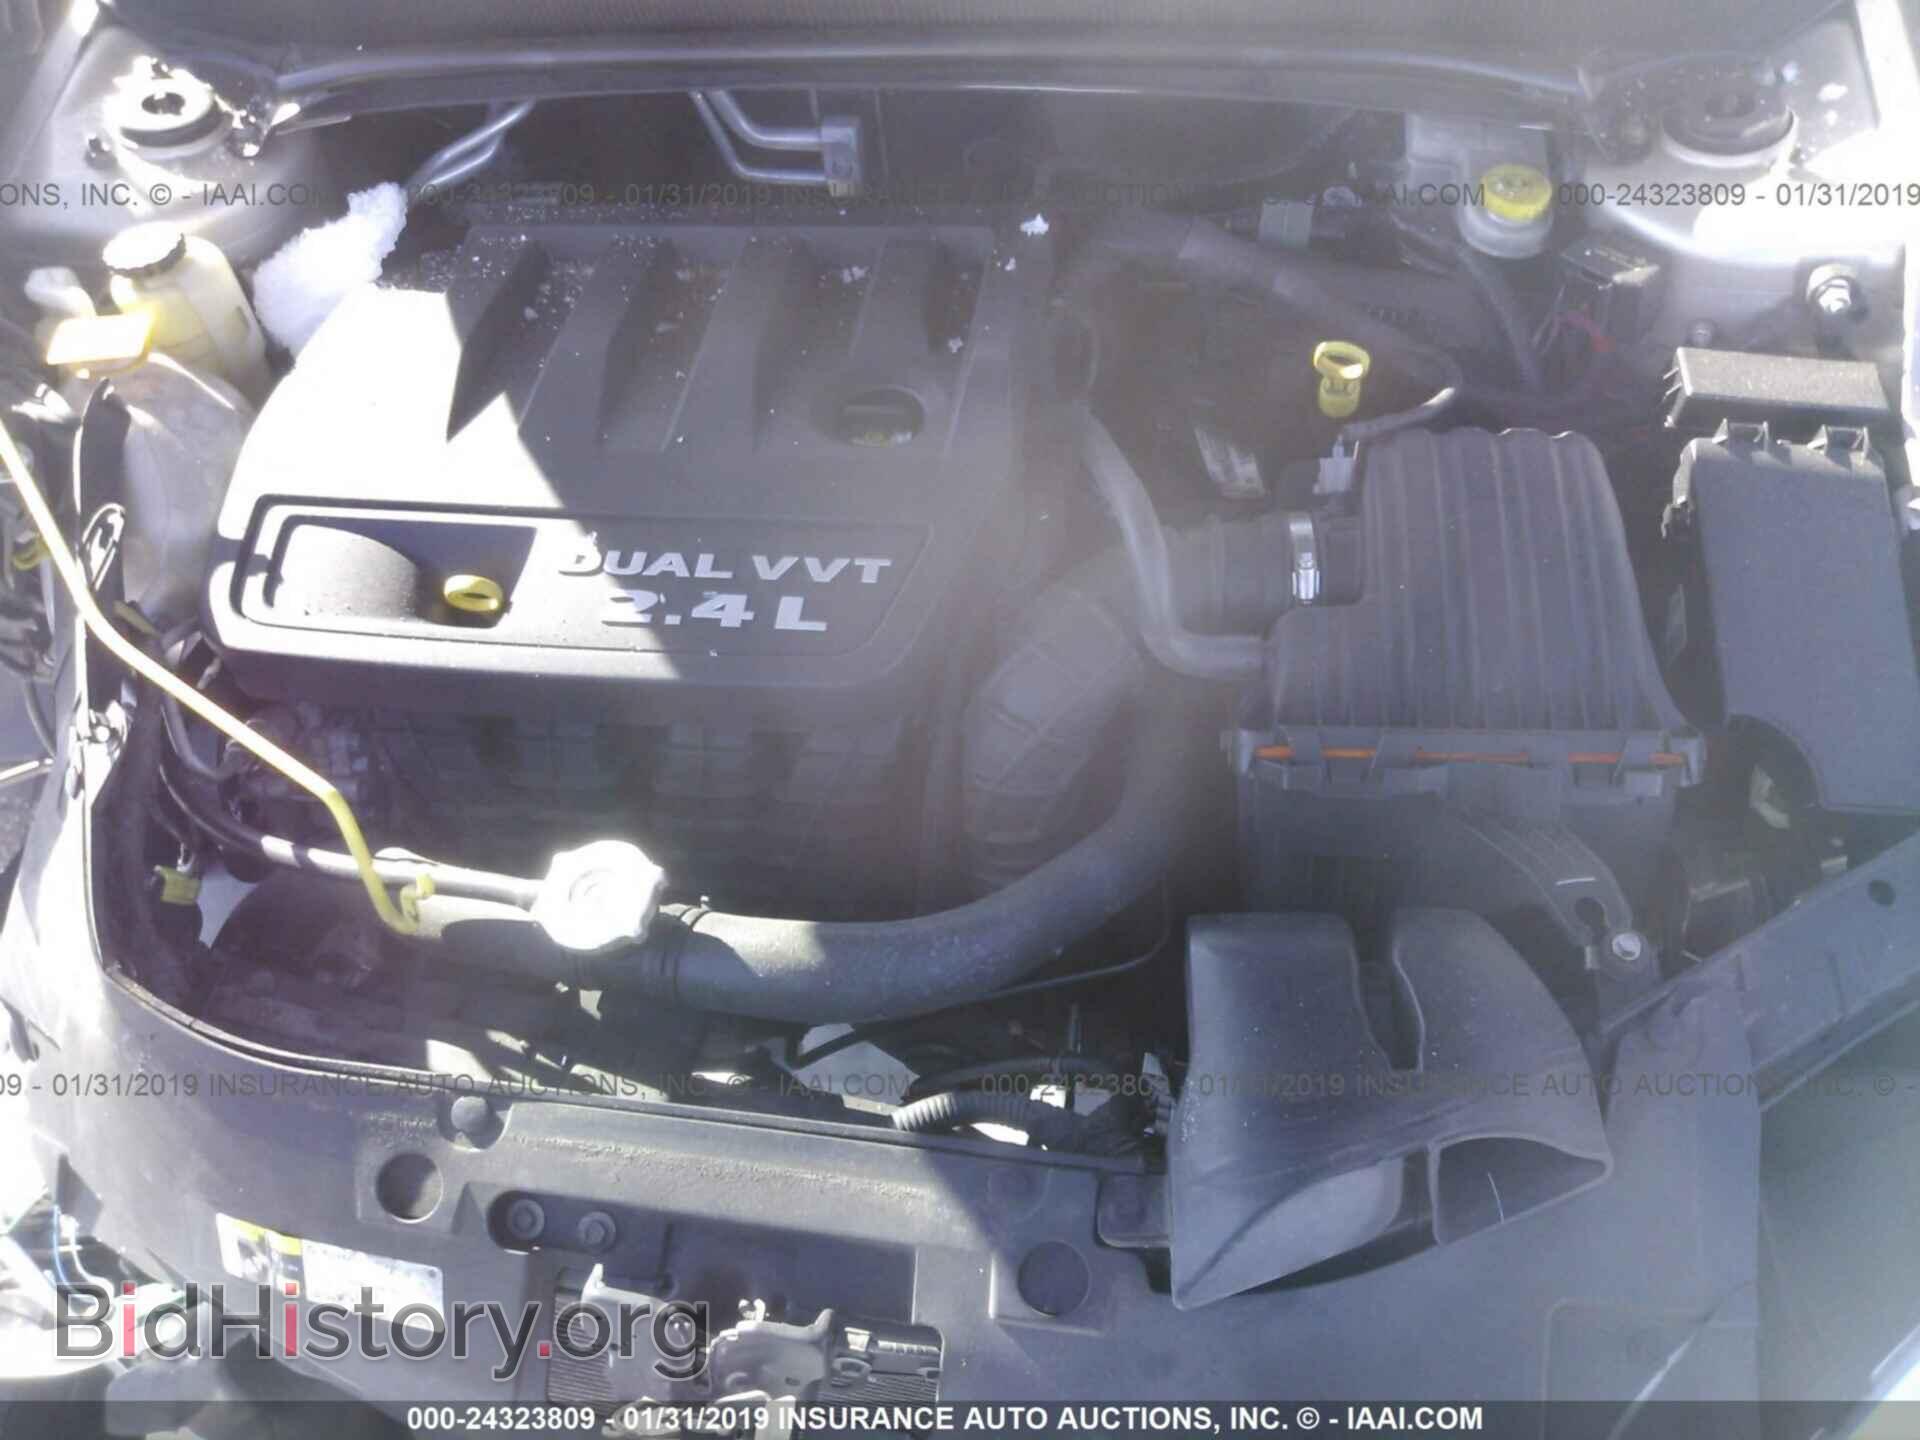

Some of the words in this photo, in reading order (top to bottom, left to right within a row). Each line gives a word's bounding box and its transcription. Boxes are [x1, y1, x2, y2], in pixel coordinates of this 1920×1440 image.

[558, 549, 733, 579] DUAL
[752, 555, 892, 584] VVT
[601, 589, 755, 629] 2.4
[773, 597, 827, 632] L
